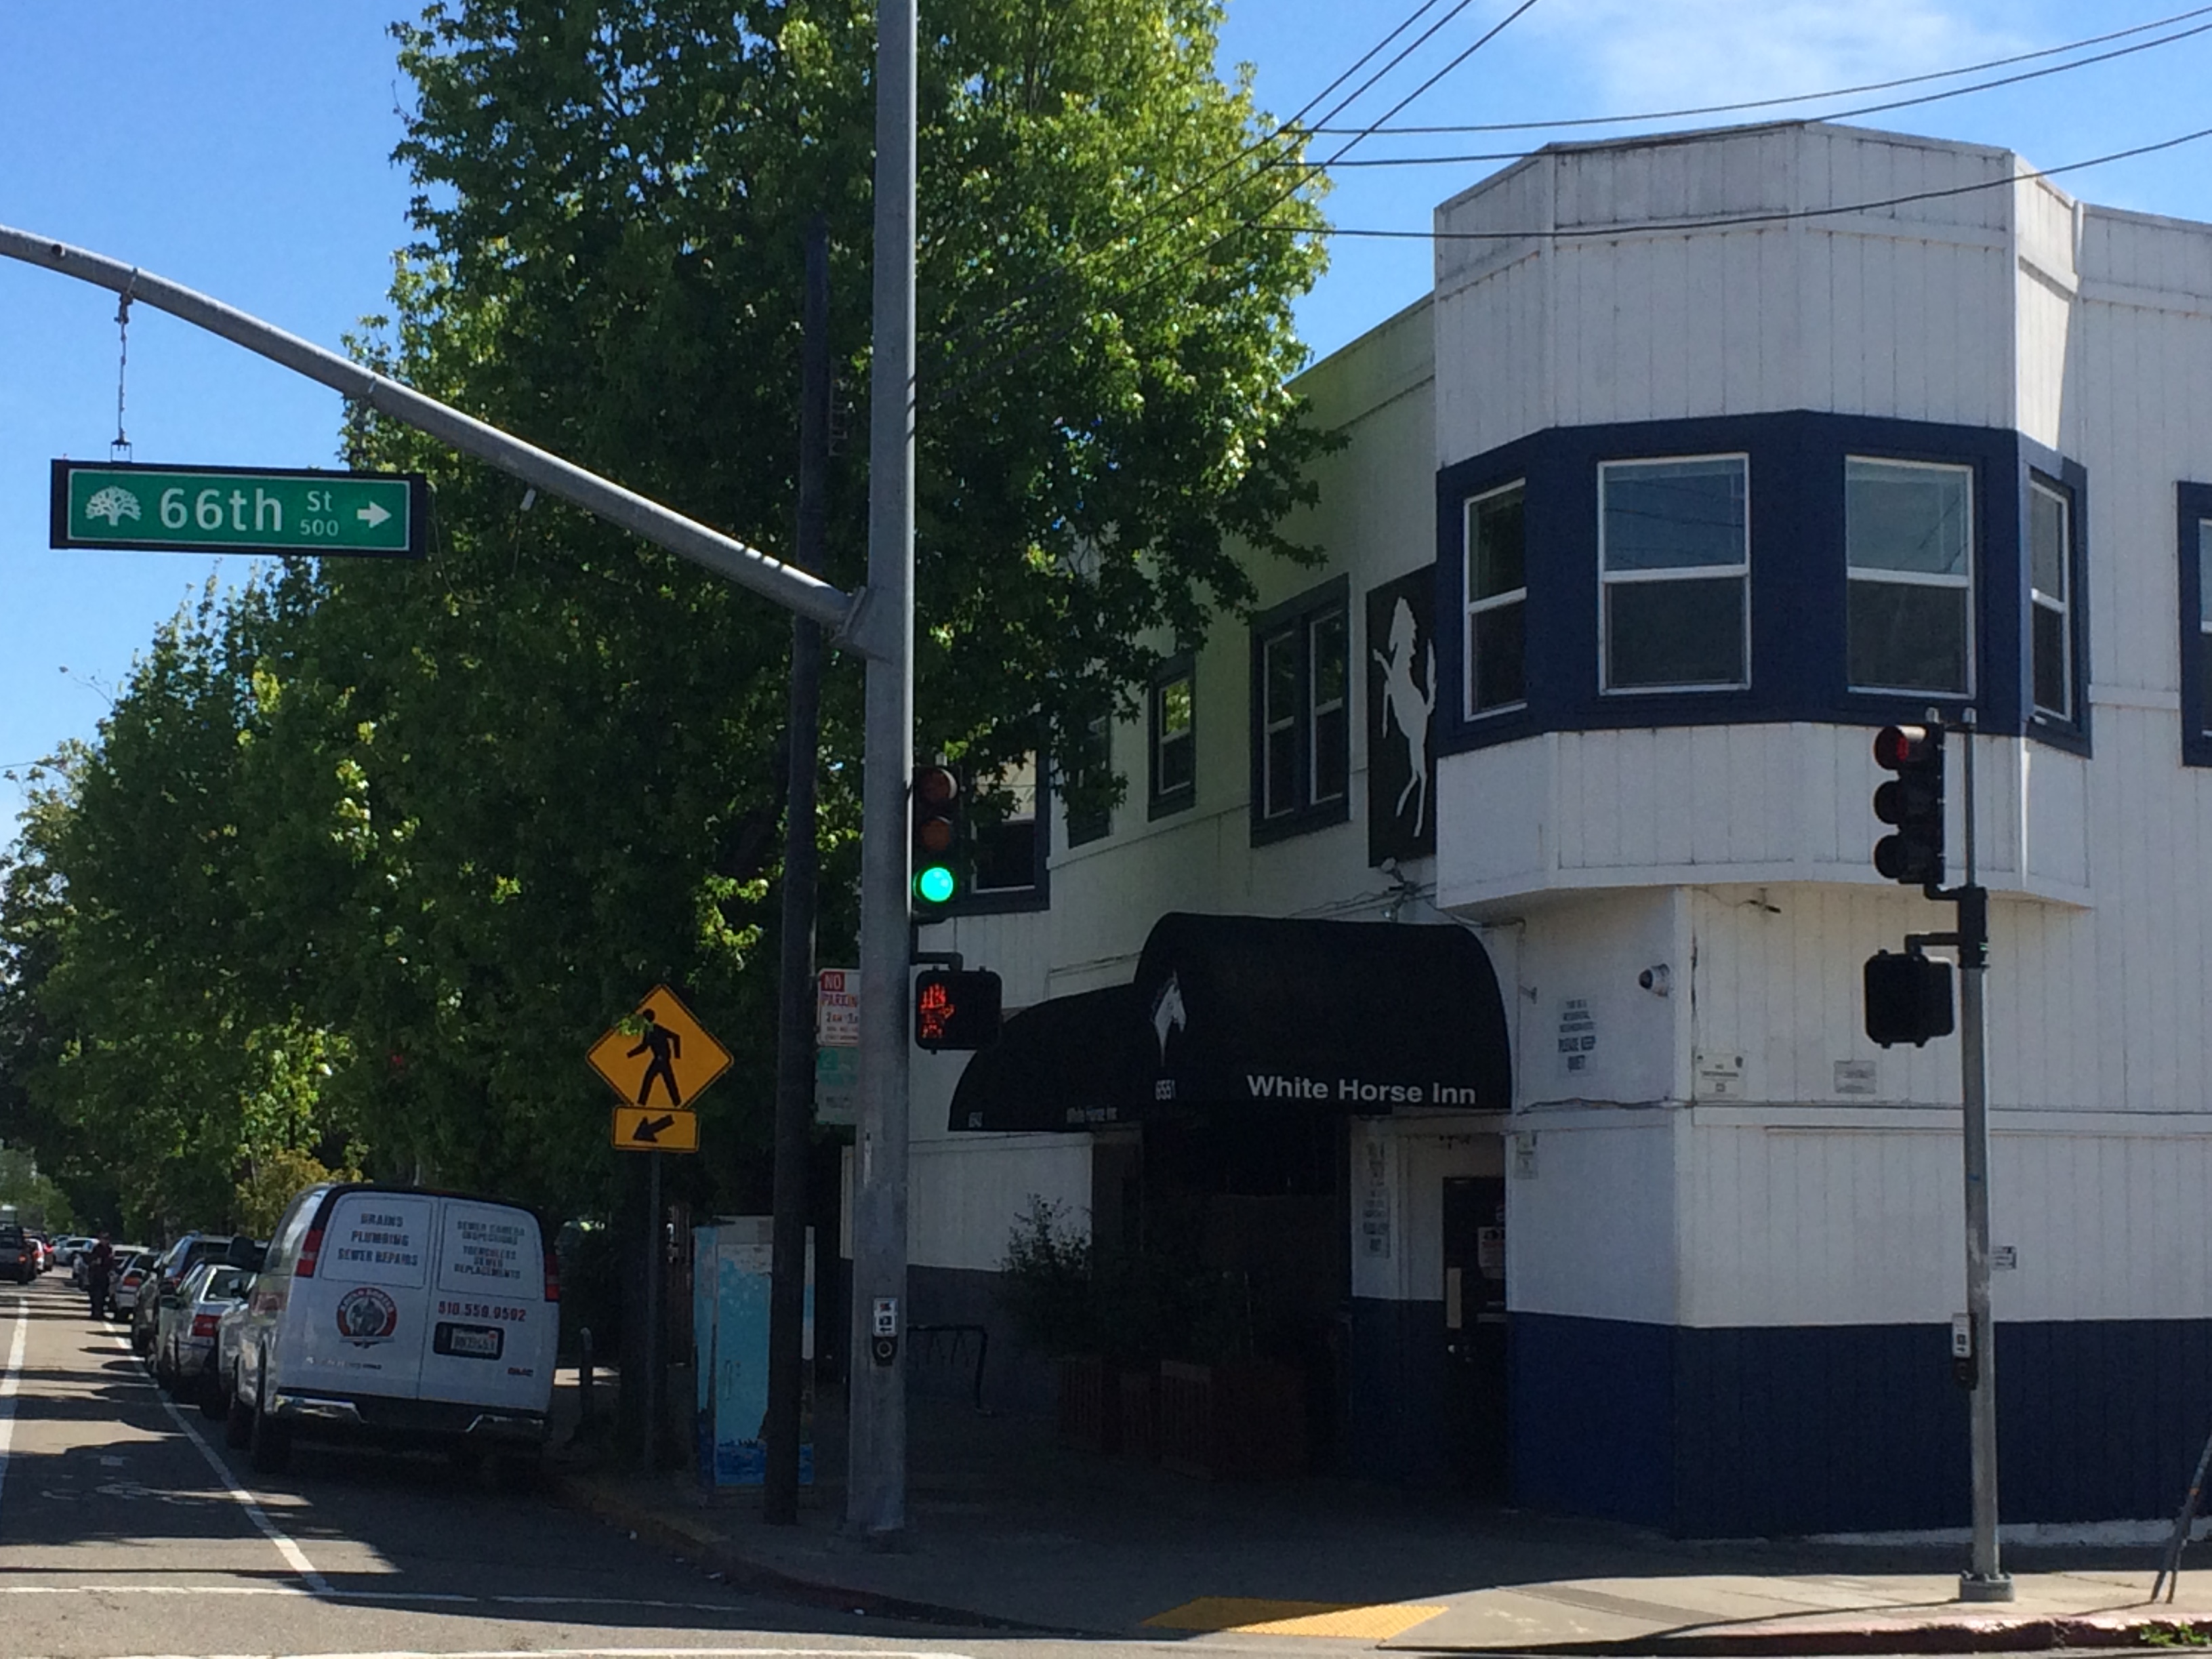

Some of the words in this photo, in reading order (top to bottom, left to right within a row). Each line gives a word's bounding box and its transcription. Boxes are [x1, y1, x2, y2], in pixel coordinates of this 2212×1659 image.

[160, 488, 282, 532] 66th
[306, 490, 333, 512] St
[300, 518, 338, 537] 500
[824, 974, 842, 990] NO
[1247, 1075, 1328, 1099] White
[1338, 1080, 1422, 1103] Horse
[1432, 1082, 1475, 1105] Inn
[351, 1231, 409, 1246] PLUMBING
